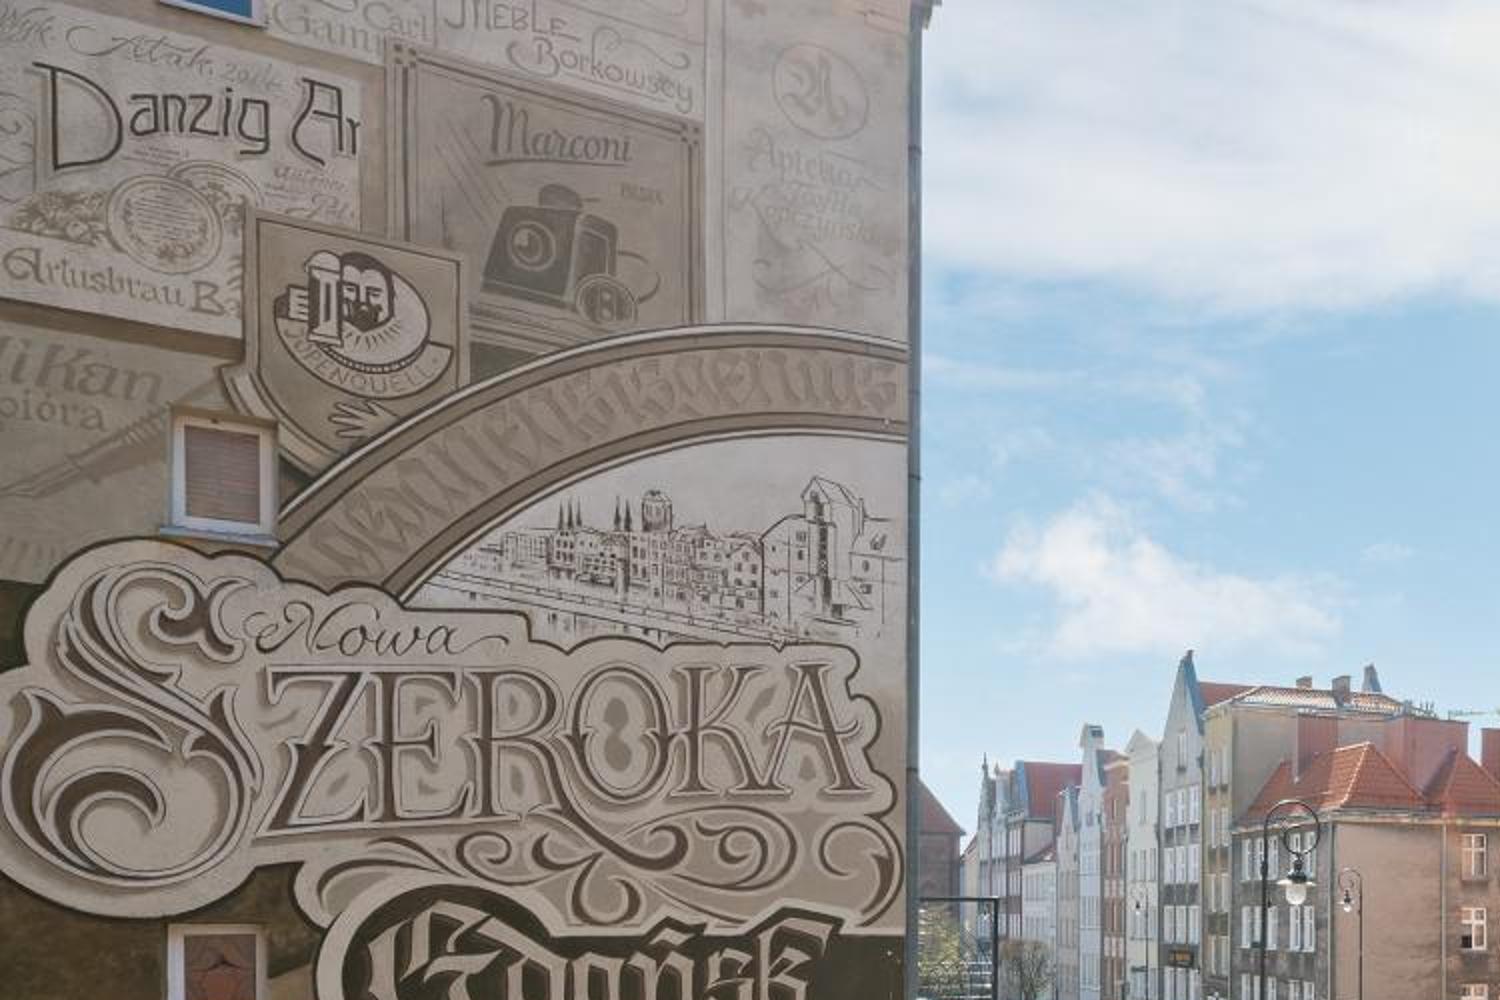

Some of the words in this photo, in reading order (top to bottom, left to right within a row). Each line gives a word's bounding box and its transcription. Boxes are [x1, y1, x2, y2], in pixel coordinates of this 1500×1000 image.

[32, 61, 271, 171] Danzig
[480, 93, 634, 161] Marconi
[243, 600, 509, 657] Nowa
[3, 562, 868, 887] SZEROKA
